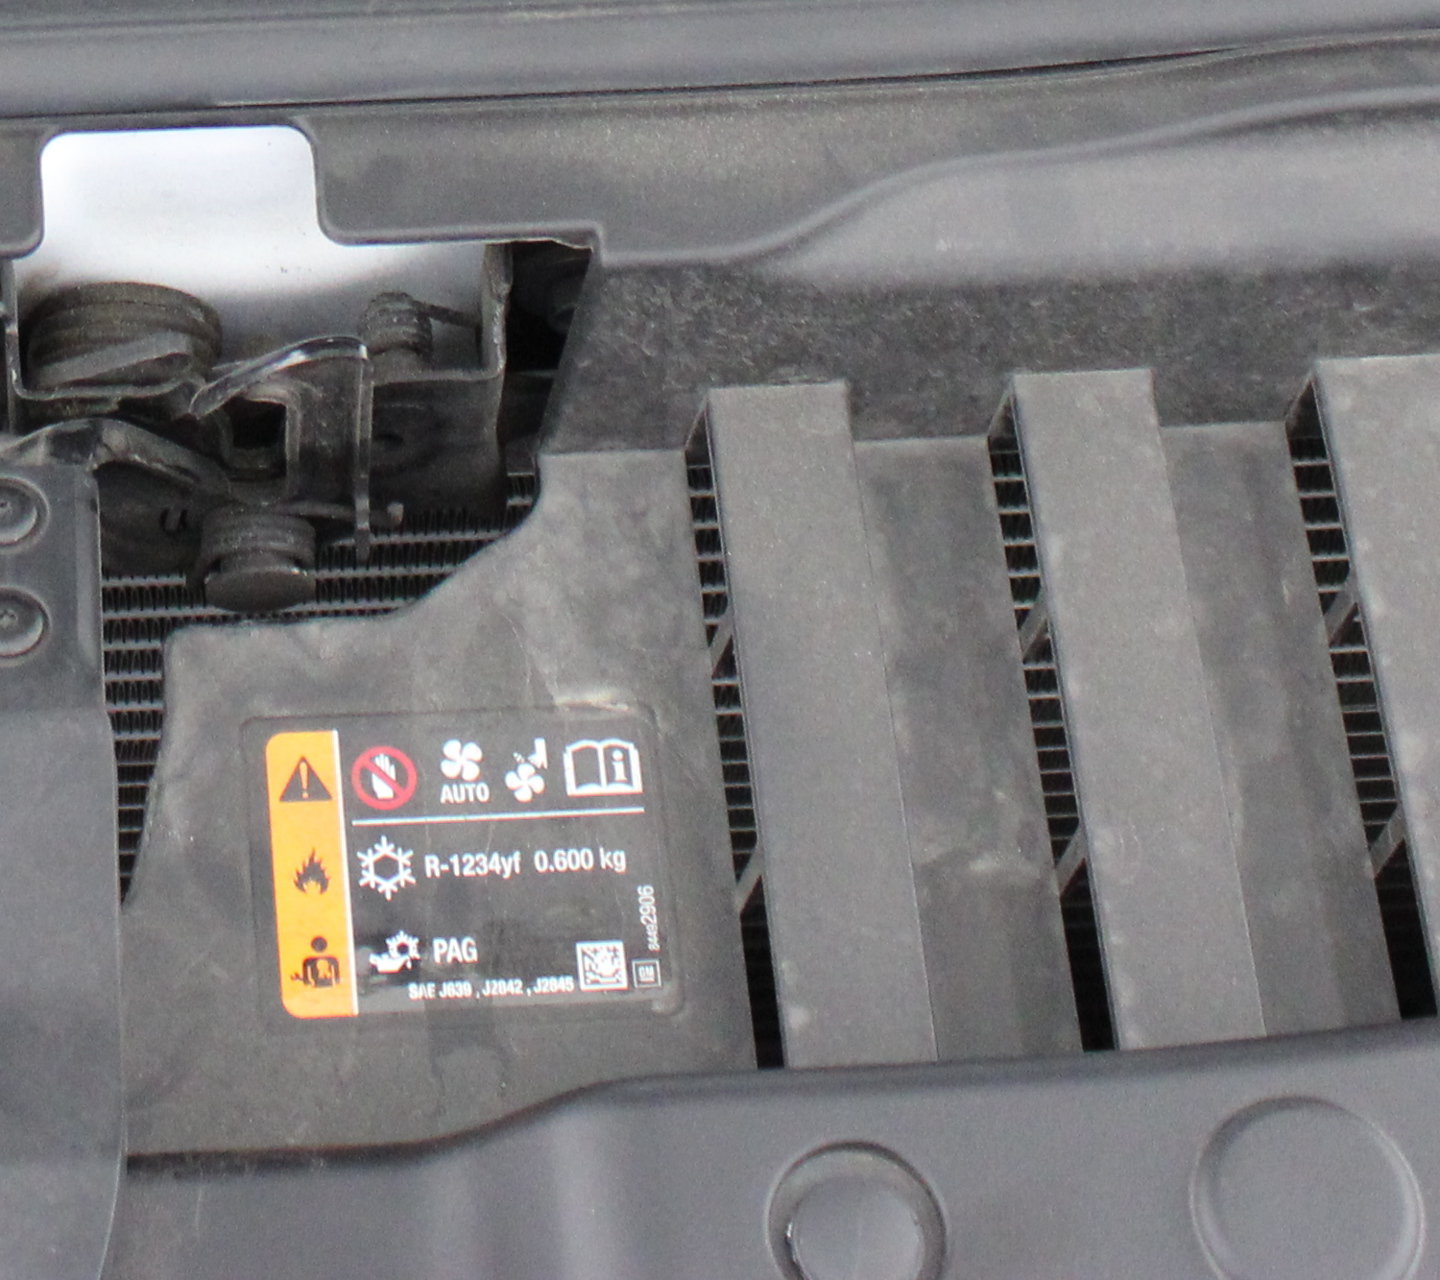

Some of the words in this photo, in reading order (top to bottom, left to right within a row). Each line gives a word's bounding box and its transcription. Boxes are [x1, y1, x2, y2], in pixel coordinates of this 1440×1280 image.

[440, 782, 489, 804] AUTO
[424, 851, 521, 879] R-1234yf
[533, 848, 594, 873] 0.600
[599, 845, 627, 873] kg
[432, 937, 479, 964] PAG
[408, 982, 435, 1001] SAE
[439, 980, 472, 999] J639
[533, 975, 575, 994] J2845
